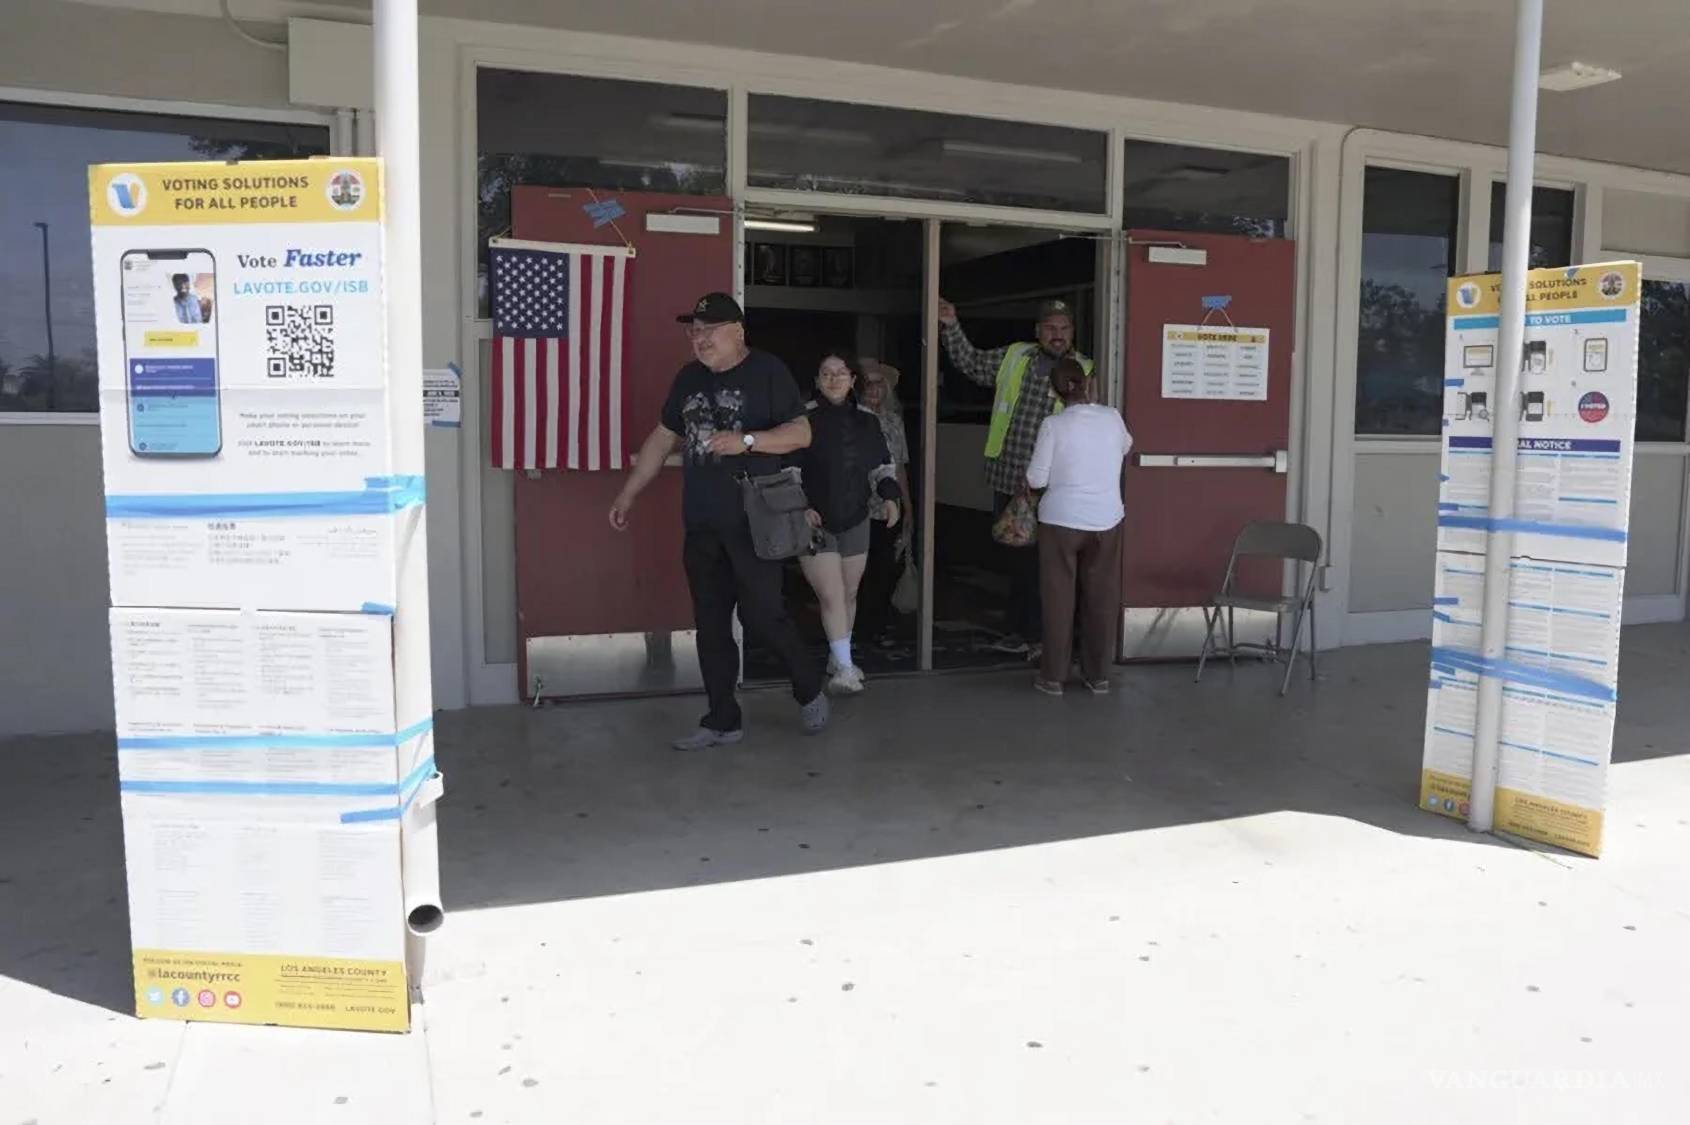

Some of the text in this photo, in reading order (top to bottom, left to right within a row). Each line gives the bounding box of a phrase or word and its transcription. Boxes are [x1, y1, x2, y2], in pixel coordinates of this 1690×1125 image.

[162, 176, 309, 191] VOTING SOLUTIONS
[174, 195, 298, 210] FOR ALL PEOPLE
[237, 249, 363, 269] Vote Faster
[233, 280, 369, 295] LAVOTE.GOV/ISB
[1529, 278, 1587, 290] SOLUTIONS
[1540, 291, 1578, 301] PEOPLE
[1529, 314, 1571, 325] TO VOTE
[1535, 440, 1571, 450] NOTICE
[281, 964, 387, 977] LOS ANGELES COUNTY
